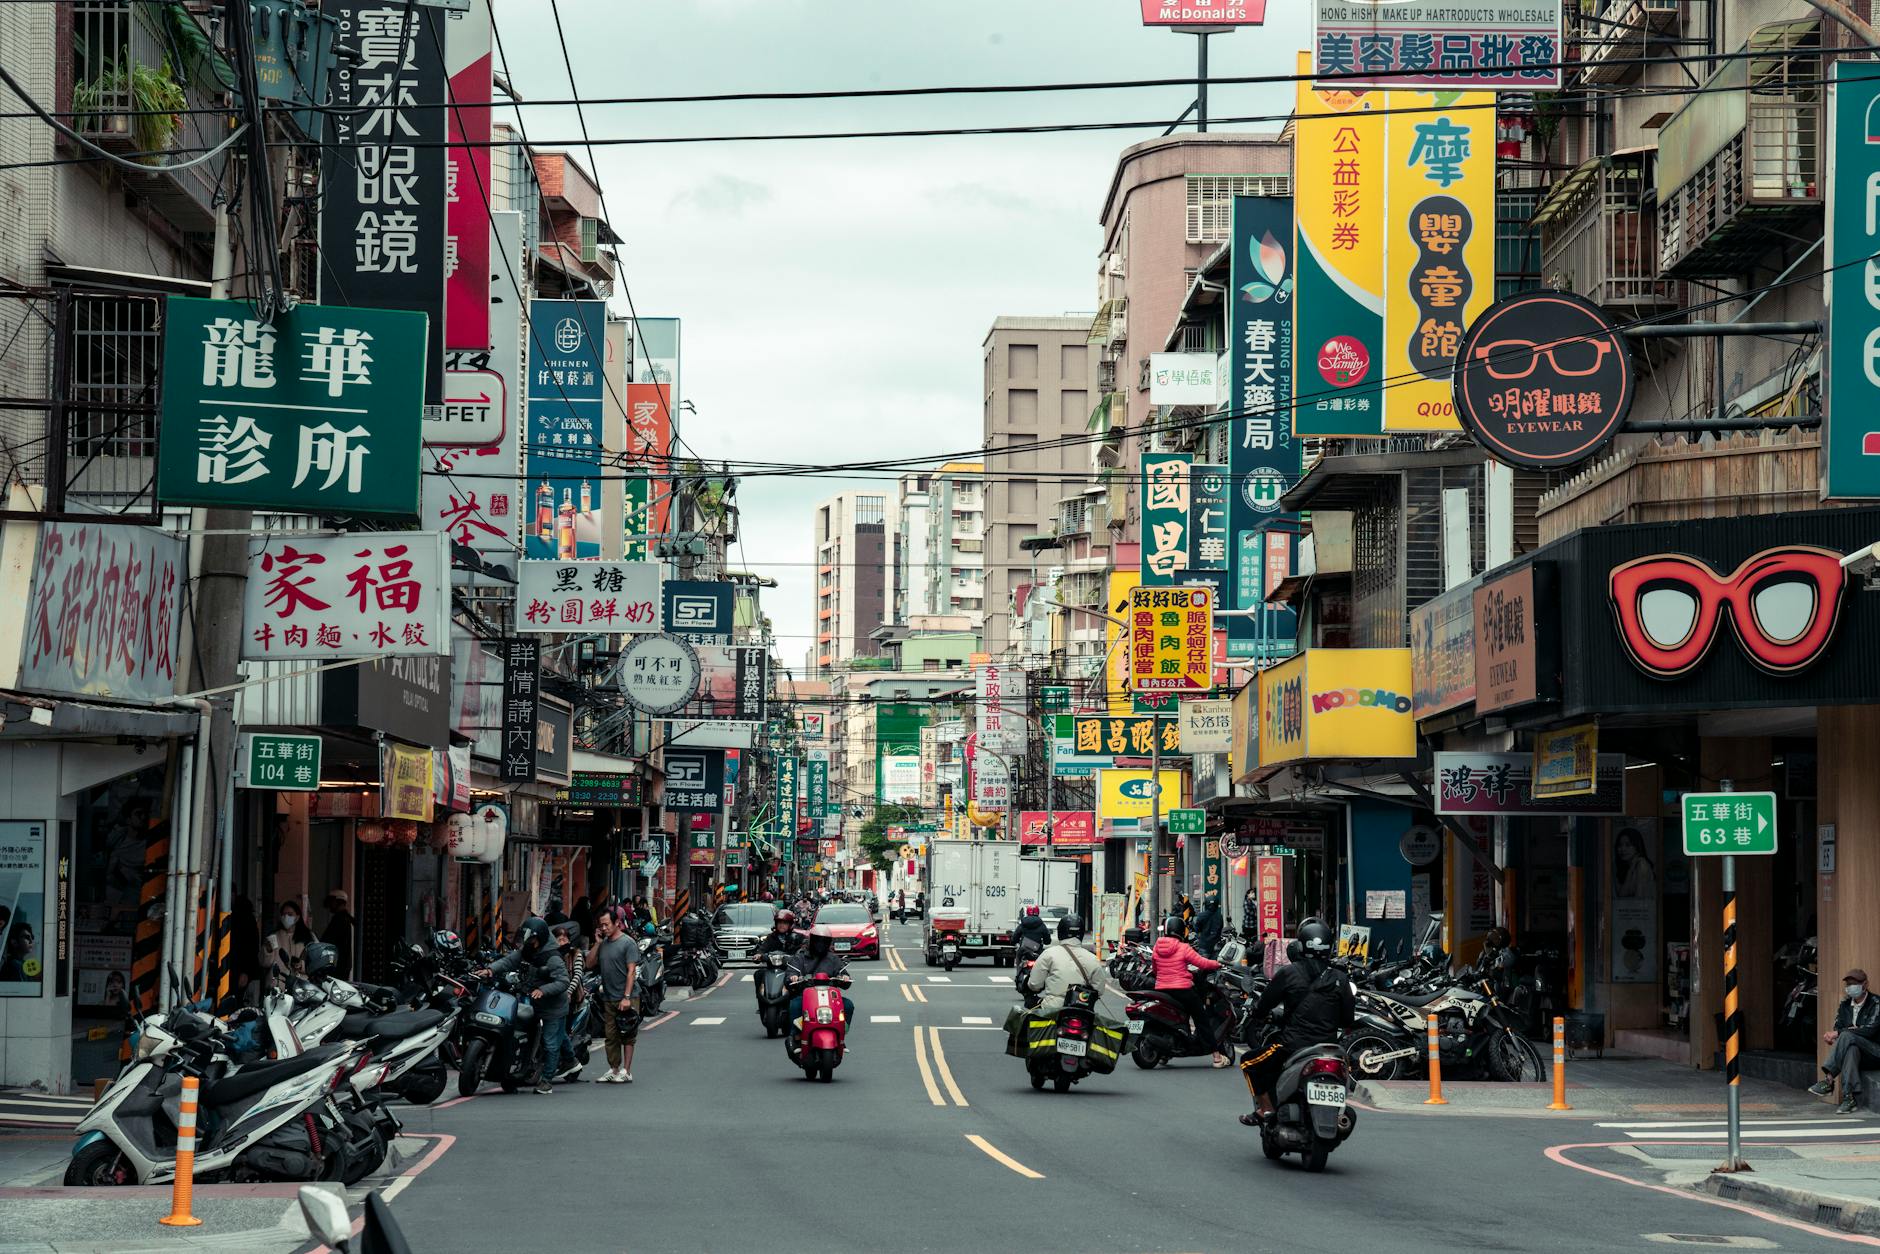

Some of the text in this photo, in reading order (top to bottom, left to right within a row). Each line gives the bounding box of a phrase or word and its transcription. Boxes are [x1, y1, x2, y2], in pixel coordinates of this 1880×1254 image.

[1160, 8, 1246, 19] McDonald's
[1321, 8, 1347, 20] HONG
[1382, 9, 1408, 21] MAKE
[1410, 9, 1422, 21] UP
[1426, 9, 1494, 22] HARTRODUCTS
[1499, 10, 1555, 22] WHOLESALE
[1319, 32, 1556, 79] 美容髮品批發
[355, 7, 421, 274] 寶來眼鏡
[1332, 127, 1361, 250] 公益彩券
[1280, 320, 1291, 369] SPRING
[201, 317, 374, 397] 龍華
[1243, 319, 1276, 451] 春天藥局
[446, 406, 490, 422] FET
[1316, 398, 1371, 411] 台灣彩券
[1506, 420, 1584, 434] EYEWEAR
[197, 414, 372, 494] 診所
[260, 544, 424, 619] 家福
[551, 566, 628, 593] 黑糖
[524, 598, 656, 626] 粉圓鮮奶
[677, 602, 712, 619] SF
[1133, 591, 1189, 609] 好好吃
[682, 633, 729, 646] 生活館
[1134, 611, 1155, 675] 魯肉便當
[1160, 611, 1180, 675] 魯肉飯
[1186, 611, 1207, 675] 脆皮蚵仔煎
[634, 656, 682, 672] 可不可
[507, 642, 535, 777] 詳情請內洽
[1311, 688, 1412, 715] KODOMO
[257, 741, 314, 761] 五華街
[259, 763, 313, 784] 104 巷
[1442, 763, 1516, 806] 鴻祥
[1690, 802, 1753, 822] 五華街
[1699, 827, 1752, 846] 63 巷
[985, 885, 1006, 897] 6295
[1389, 1002, 1417, 1020] 187
[1308, 1089, 1345, 1104] LU9-589
